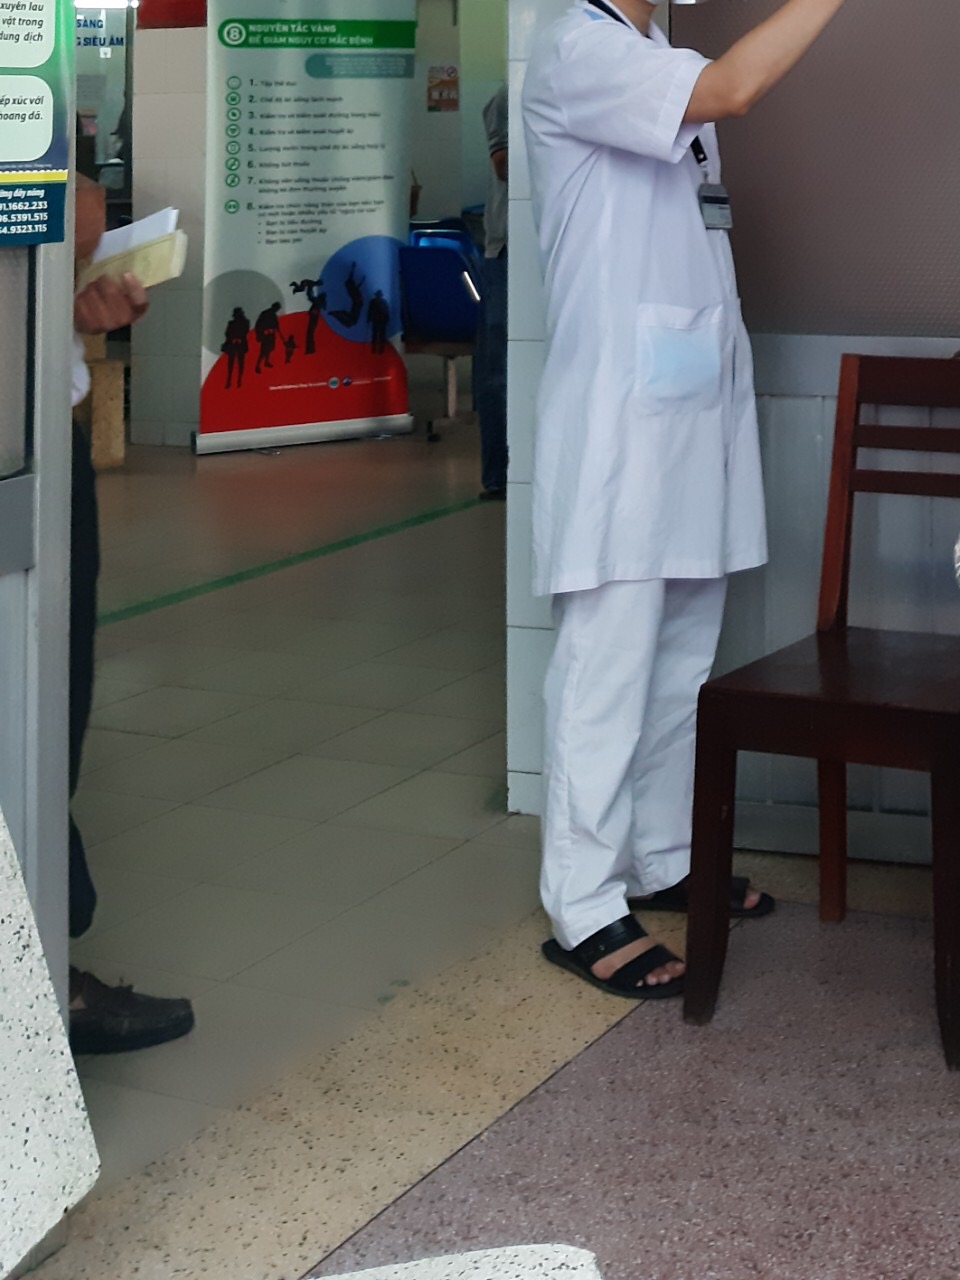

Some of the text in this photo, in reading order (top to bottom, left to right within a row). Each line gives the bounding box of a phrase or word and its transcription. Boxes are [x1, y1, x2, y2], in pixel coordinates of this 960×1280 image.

[28, 1, 44, 12] lau
[18, 17, 44, 29] trong
[229, 26, 241, 41] 8
[0, 223, 49, 234] 4.9323.115
